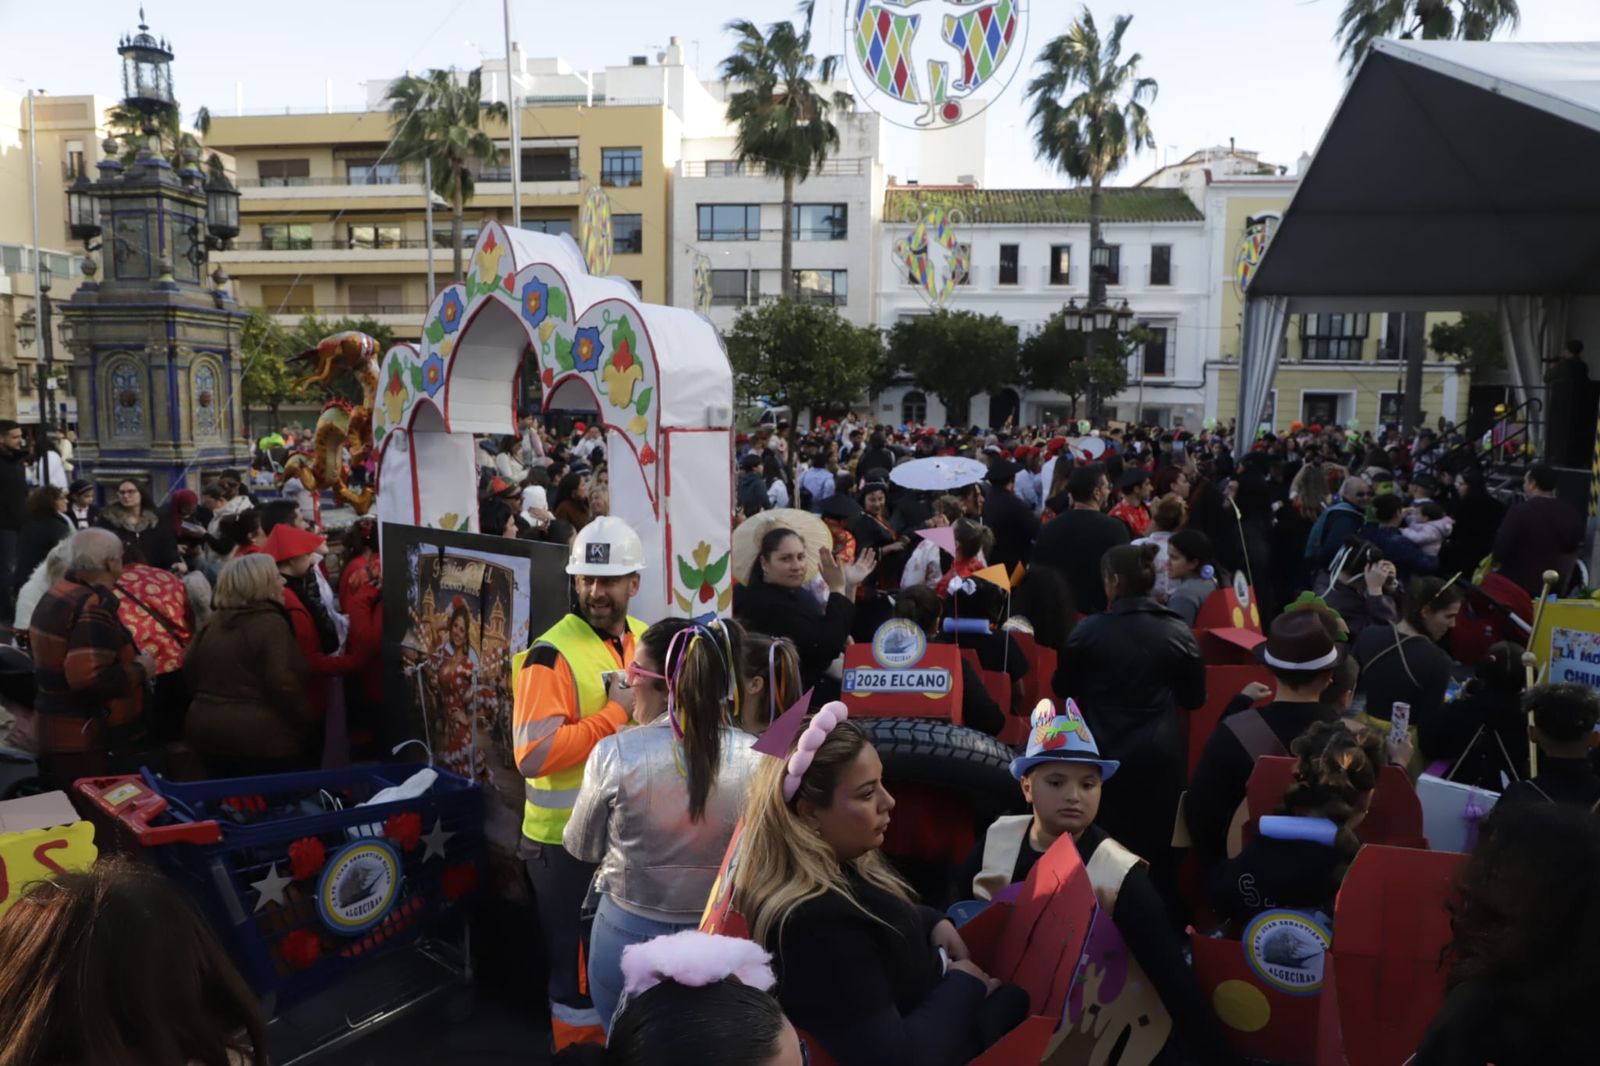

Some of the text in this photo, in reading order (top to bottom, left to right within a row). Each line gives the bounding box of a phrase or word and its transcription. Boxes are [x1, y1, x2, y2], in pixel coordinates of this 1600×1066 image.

[856, 673, 946, 688] 2026 ELCANO
[1269, 967, 1317, 984] ALGECIRAS
